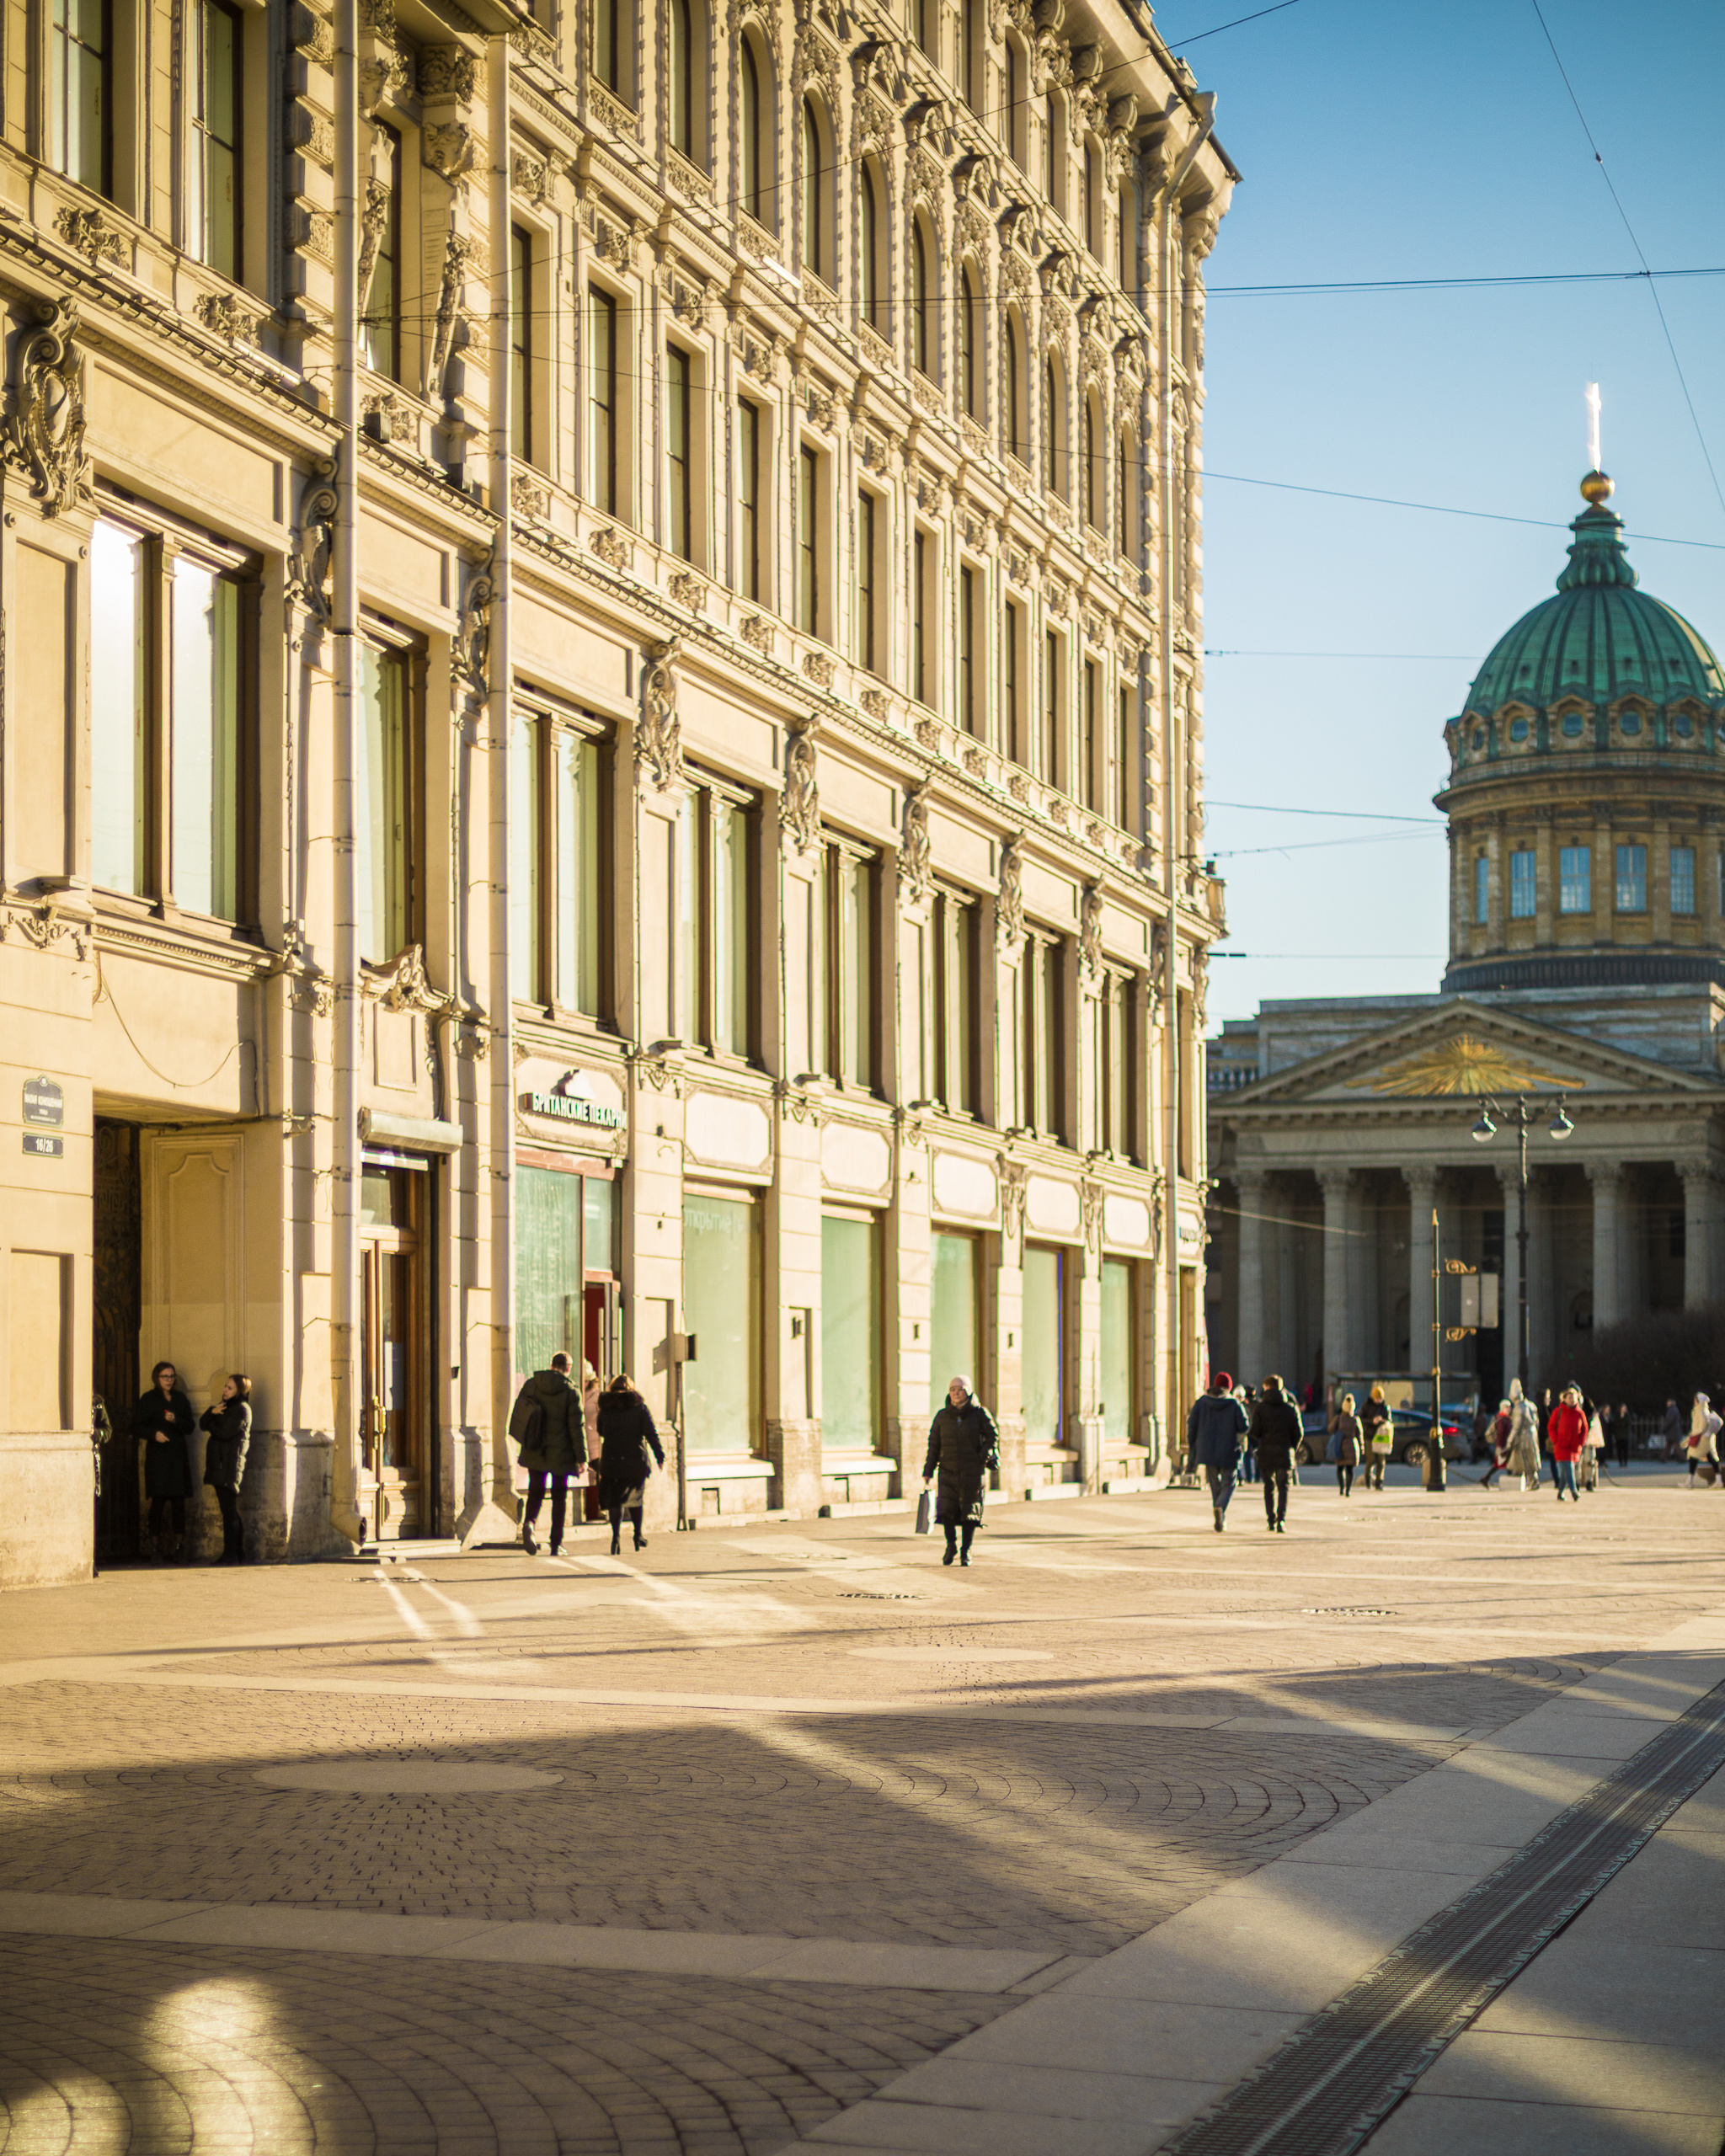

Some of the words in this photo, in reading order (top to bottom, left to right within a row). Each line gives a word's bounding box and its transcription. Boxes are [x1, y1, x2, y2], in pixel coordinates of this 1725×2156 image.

[532, 1091, 589, 1122] БРИТАНСКИЕ
[589, 1103, 628, 1130] ПЕКАРНИ
[35, 1137, 54, 1154] 16/26
